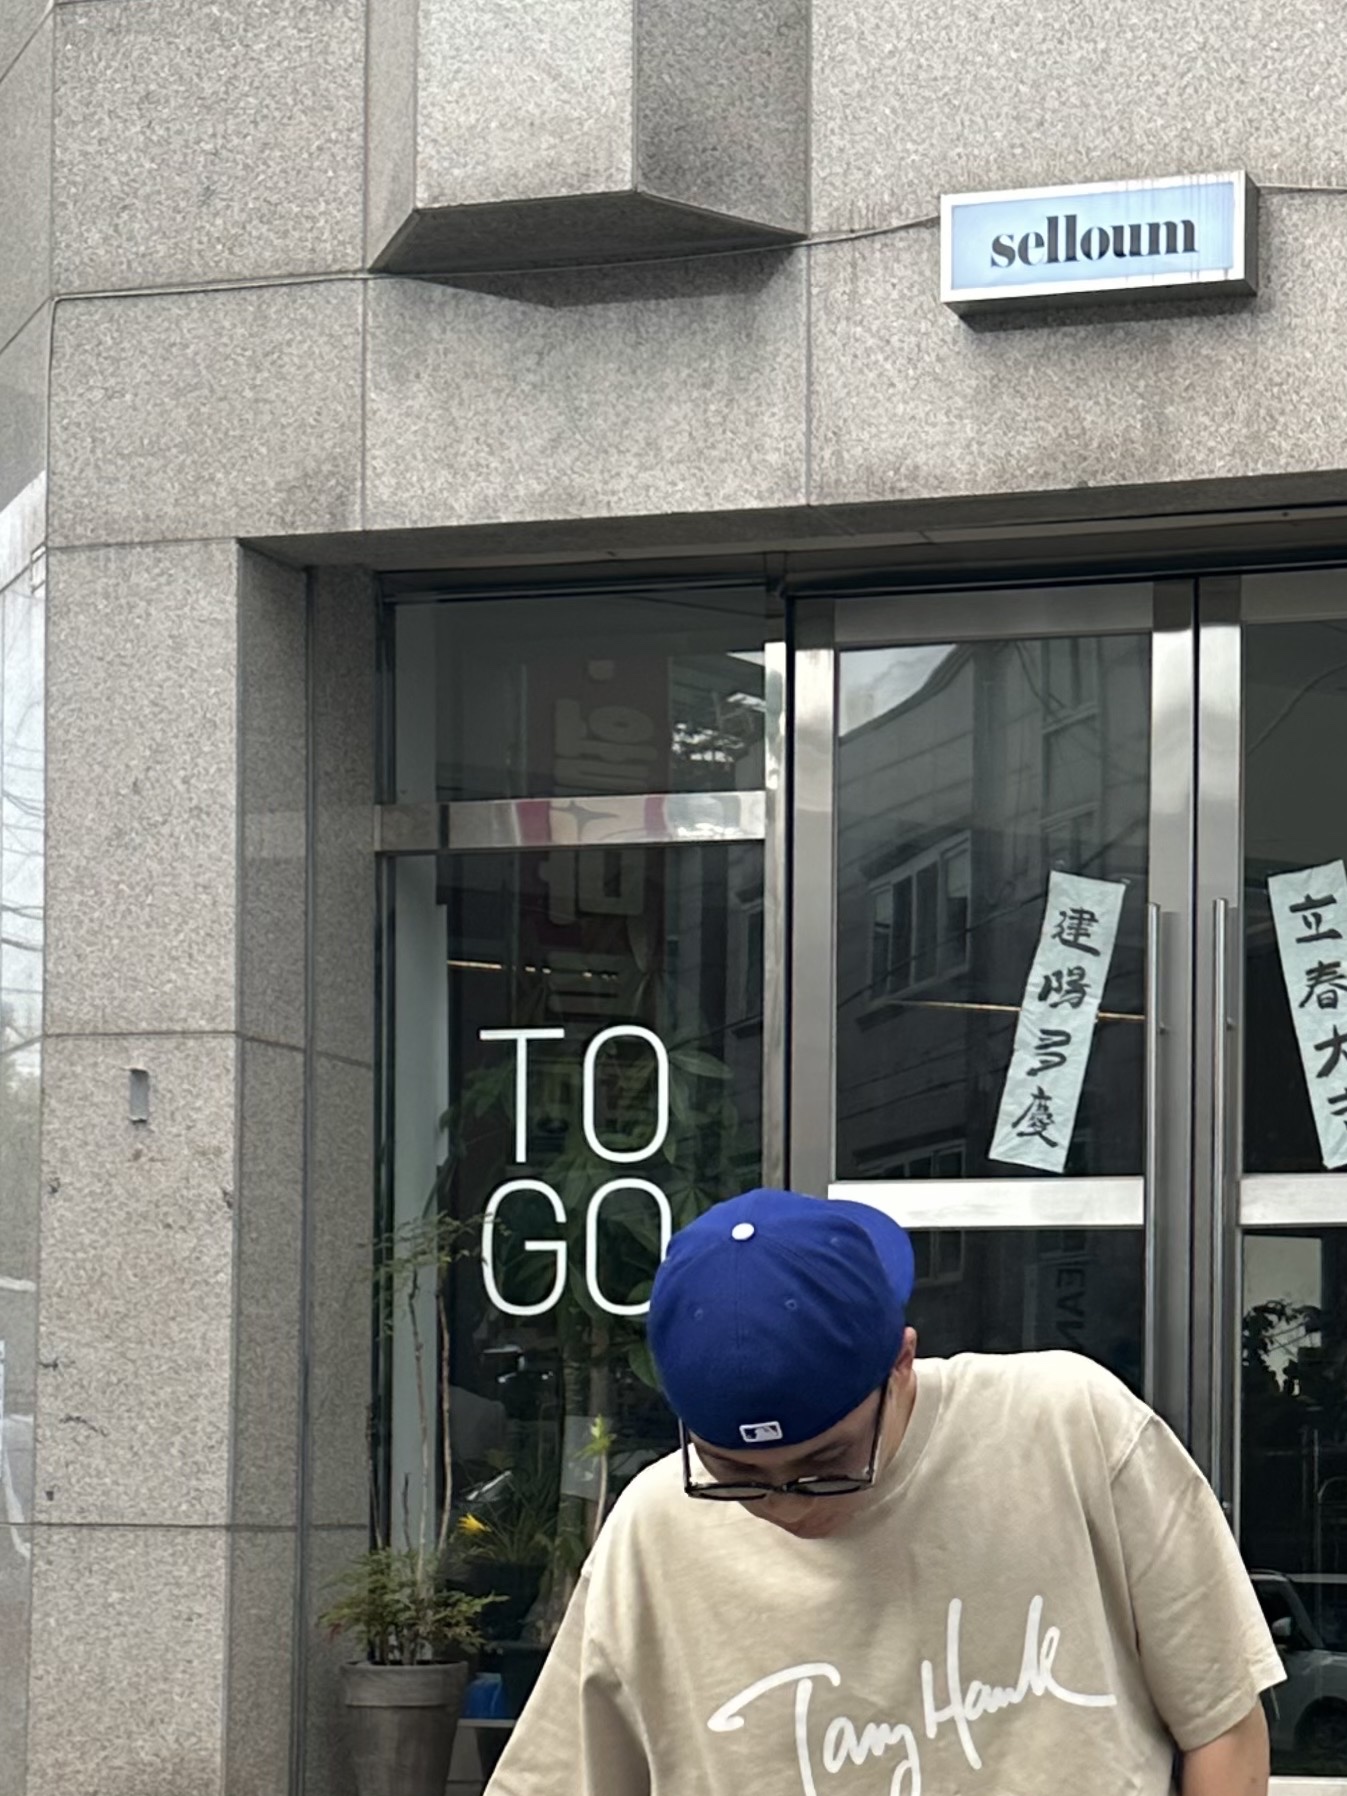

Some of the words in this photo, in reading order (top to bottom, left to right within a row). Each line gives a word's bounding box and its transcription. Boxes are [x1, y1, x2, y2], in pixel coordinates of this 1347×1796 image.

[990, 213, 1199, 269] selloum
[478, 1024, 670, 1165] TO
[480, 1177, 674, 1317] GO
